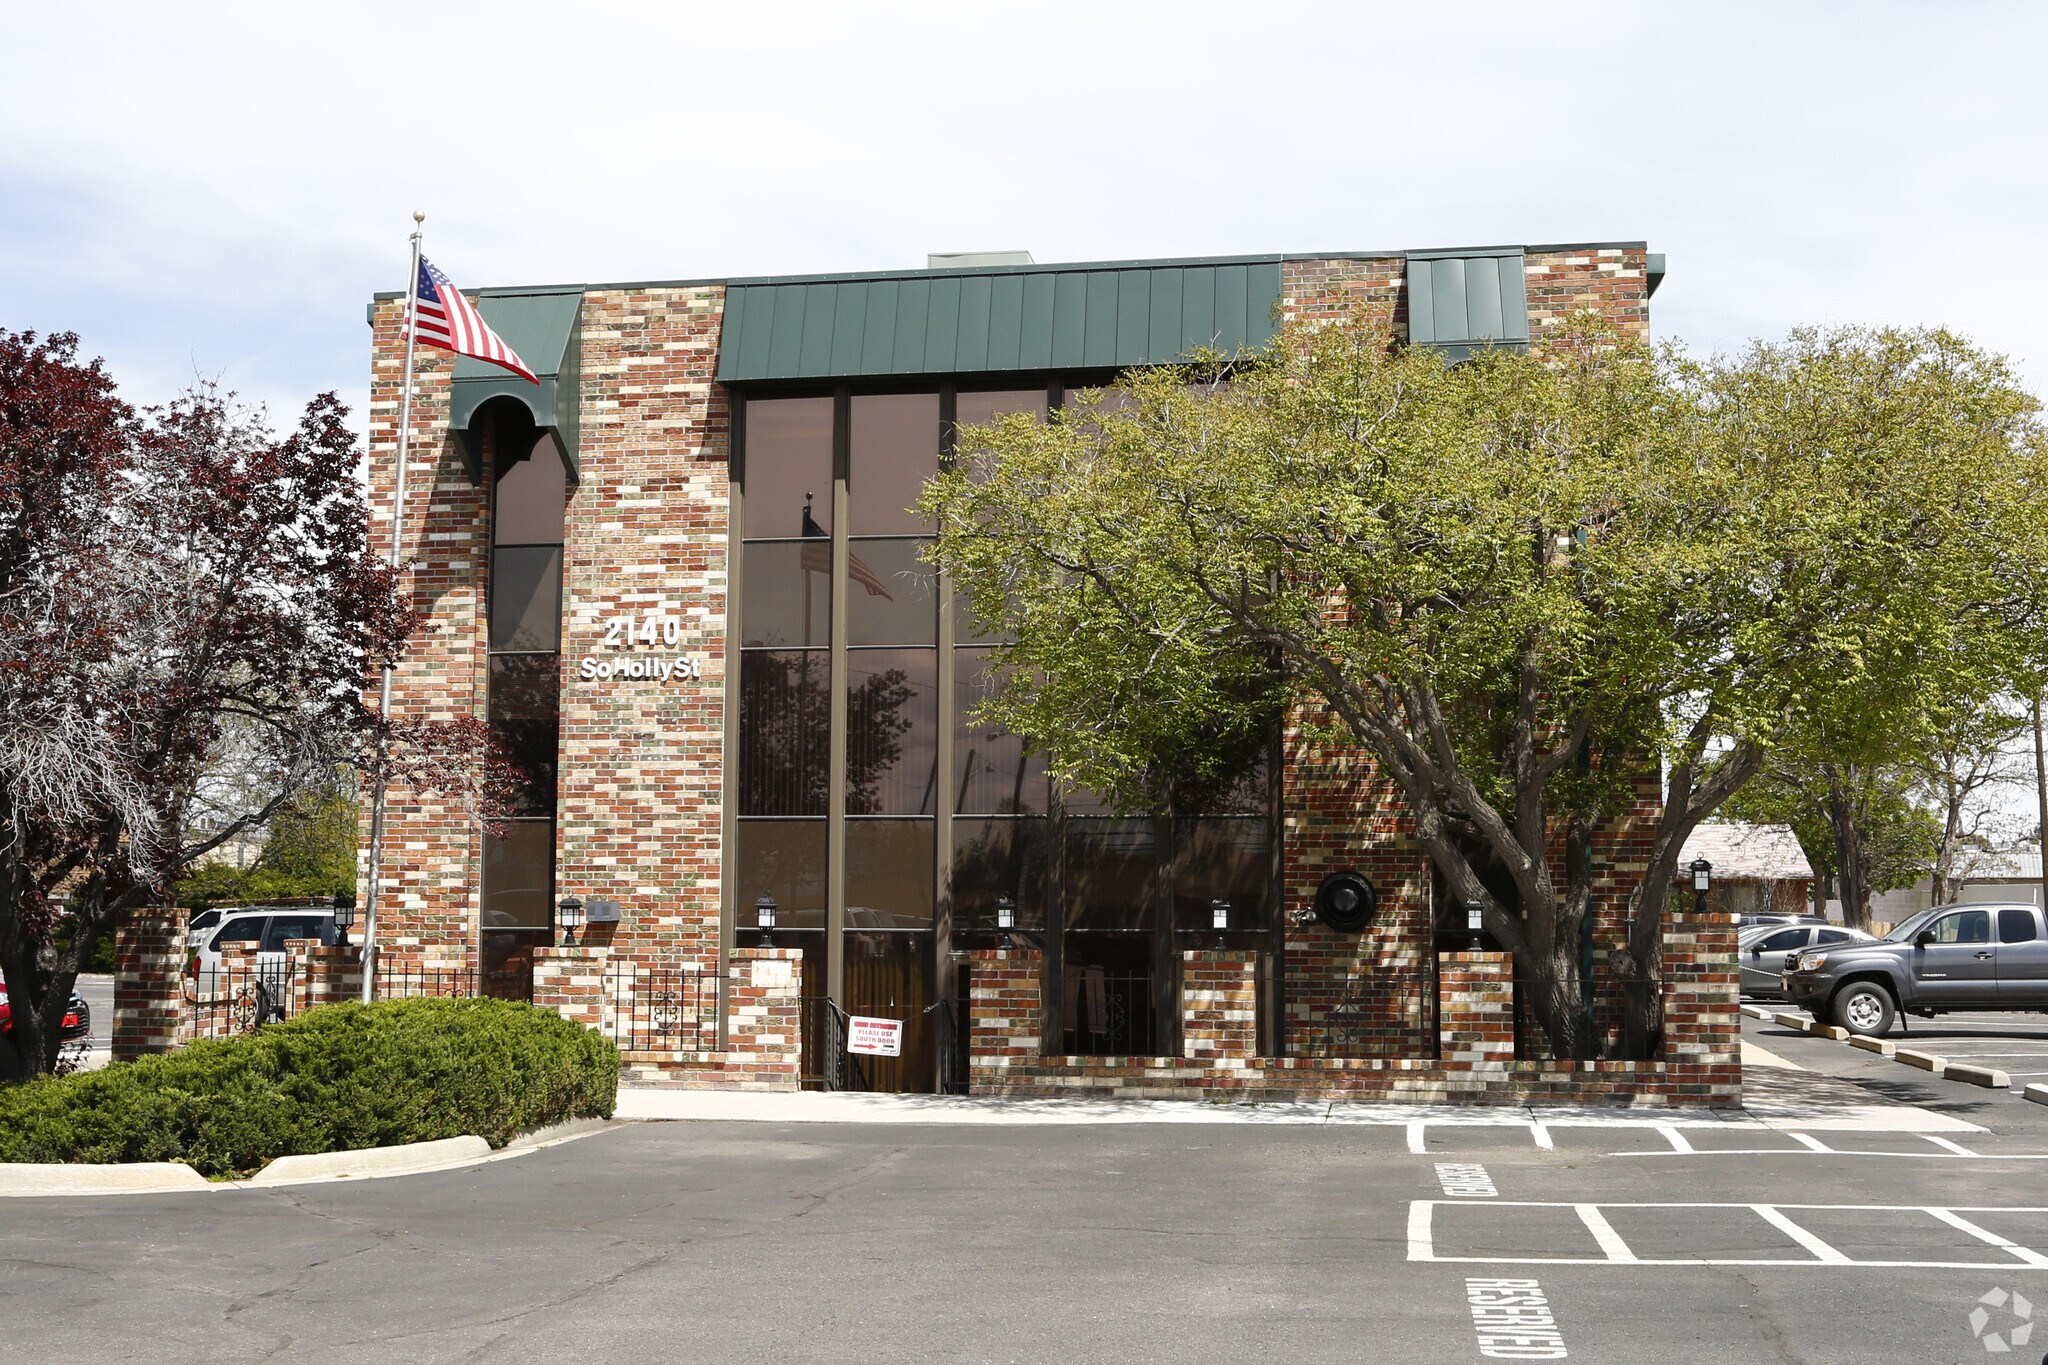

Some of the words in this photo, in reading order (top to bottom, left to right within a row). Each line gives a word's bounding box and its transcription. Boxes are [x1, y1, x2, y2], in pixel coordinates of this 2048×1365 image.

[604, 616, 680, 645] 2140
[1433, 1162, 1499, 1197] RESERVED
[1465, 1278, 1568, 1359] RESERVED
